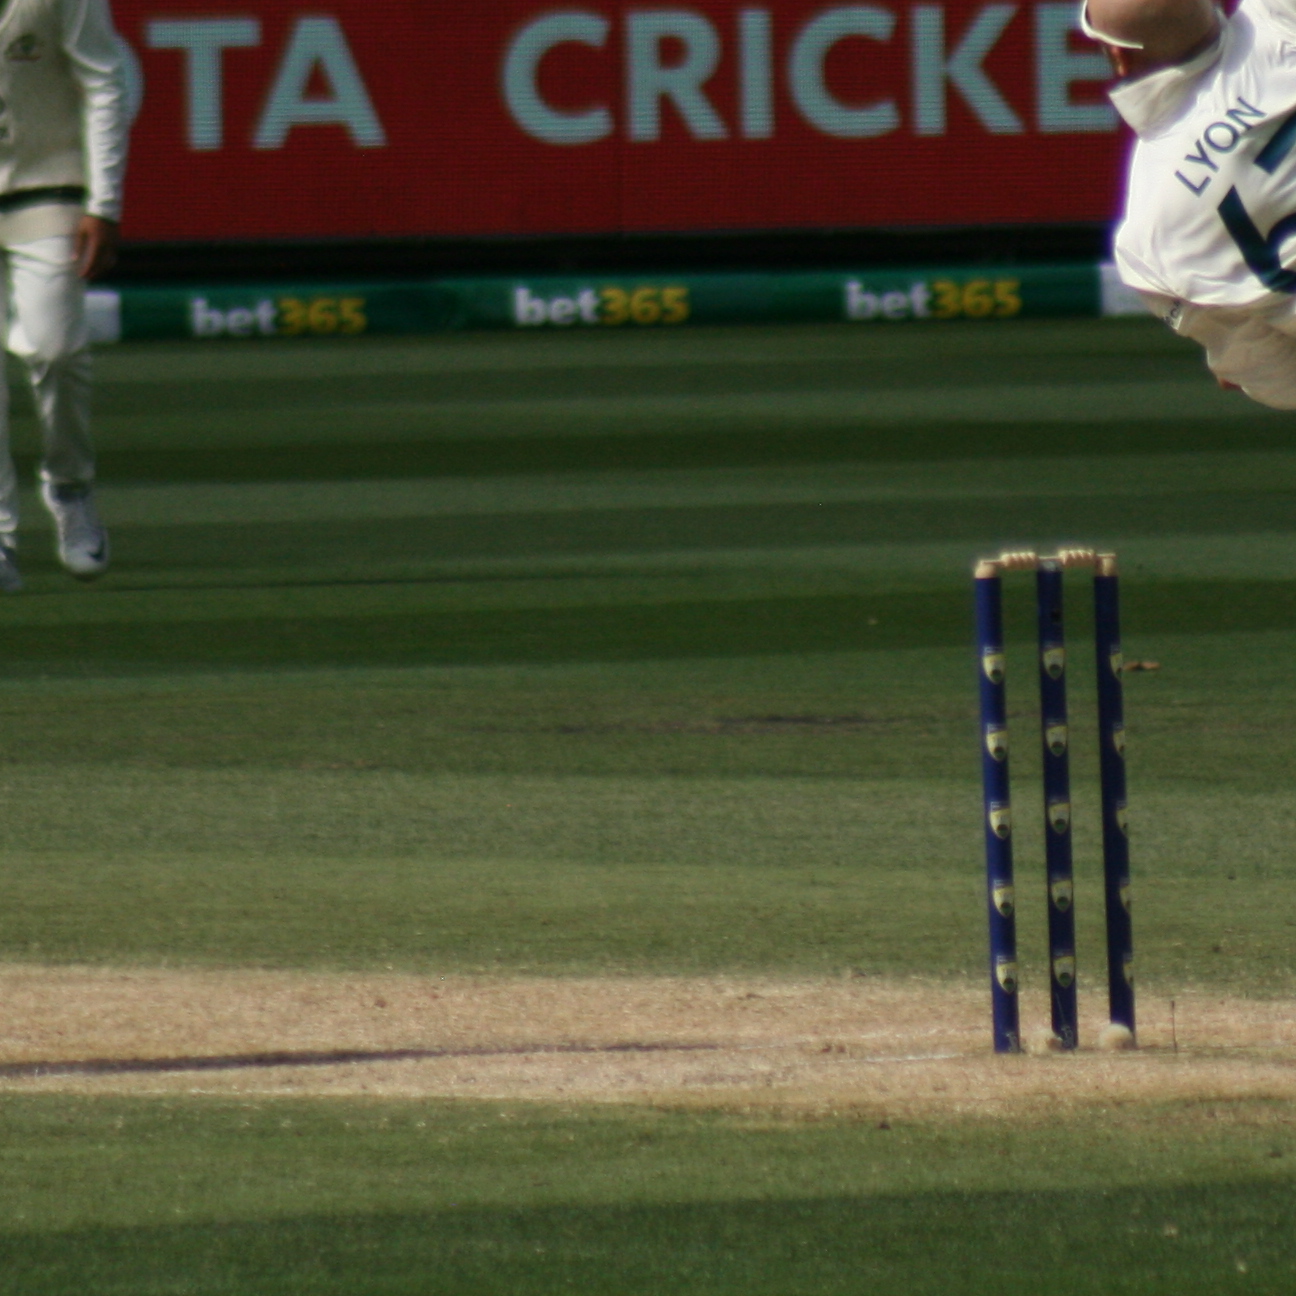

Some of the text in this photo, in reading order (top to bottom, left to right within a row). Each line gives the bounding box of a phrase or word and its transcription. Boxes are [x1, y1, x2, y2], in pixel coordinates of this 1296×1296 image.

[502, 2, 1116, 144] CRICKE
[1174, 96, 1268, 197] LYON
[190, 296, 368, 338] bet365
[515, 286, 689, 327] bet365
[845, 277, 1022, 320] bet365
